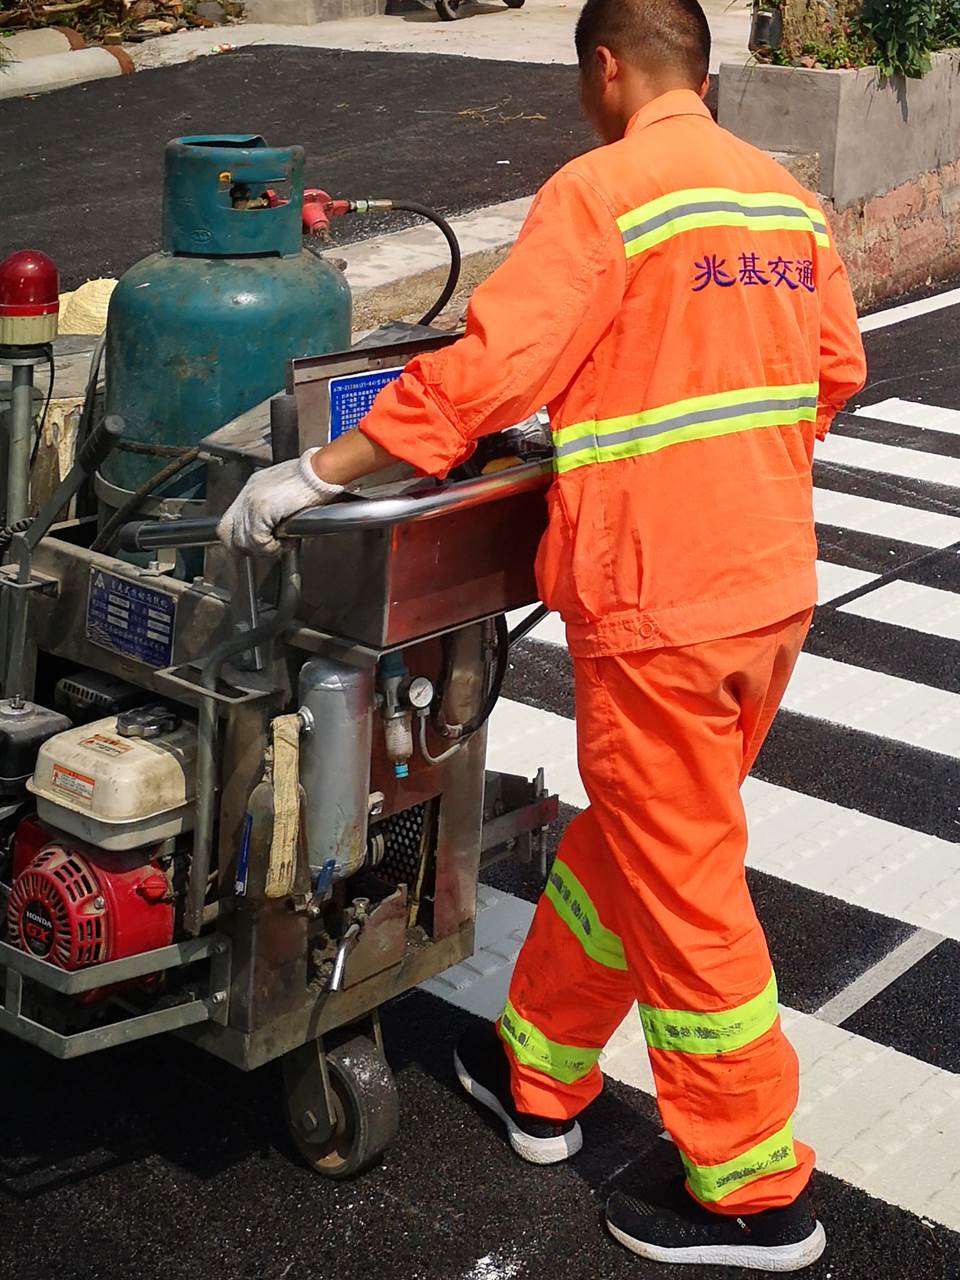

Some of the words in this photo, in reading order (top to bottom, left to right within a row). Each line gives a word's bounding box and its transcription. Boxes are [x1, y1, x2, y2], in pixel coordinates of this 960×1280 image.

[691, 252, 816, 293] 兆基交通
[26, 910, 53, 929] HONDA
[26, 922, 49, 944] GX
